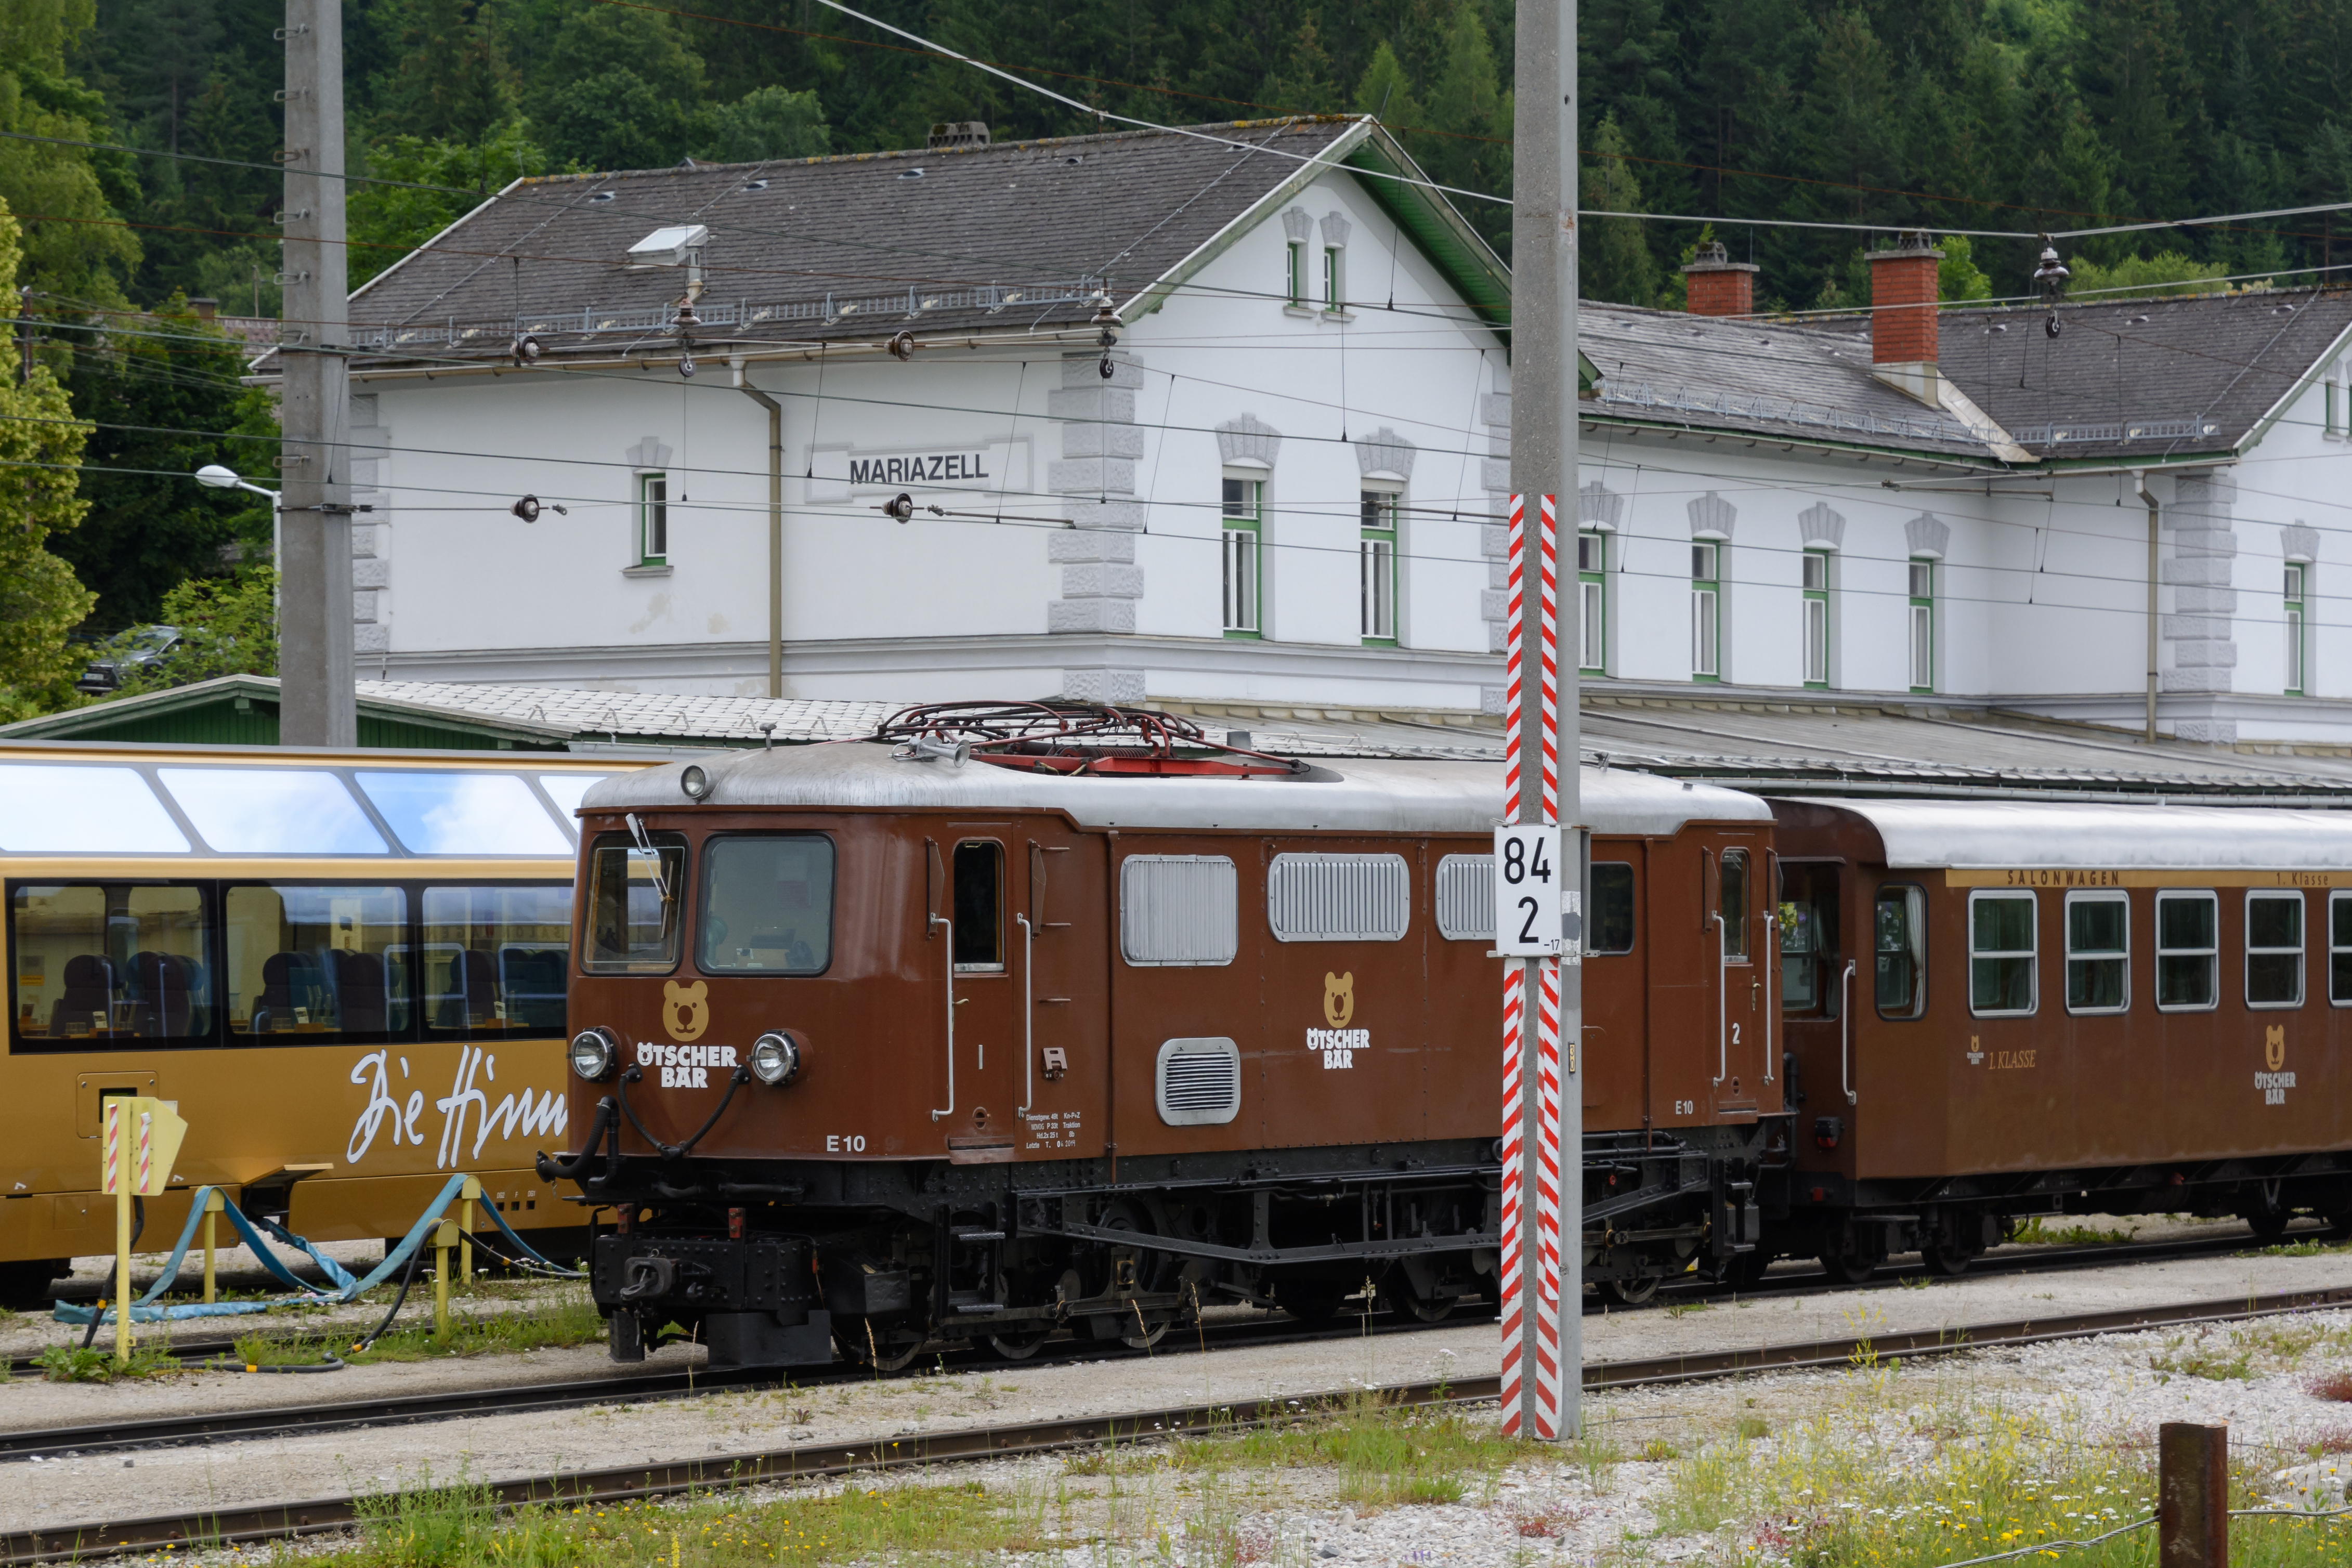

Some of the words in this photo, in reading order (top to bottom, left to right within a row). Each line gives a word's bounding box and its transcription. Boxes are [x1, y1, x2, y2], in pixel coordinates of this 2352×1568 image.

[850, 453, 989, 485] MARIAZELL
[1505, 837, 1551, 884] 84
[2008, 870, 2118, 885] SALONWAGEN
[2276, 872, 2285, 885] 1.
[2292, 872, 2328, 885] Klasse
[1518, 896, 1539, 944] 2
[1732, 1022, 1741, 1044] 2
[1997, 1050, 2036, 1069] KLASSE
